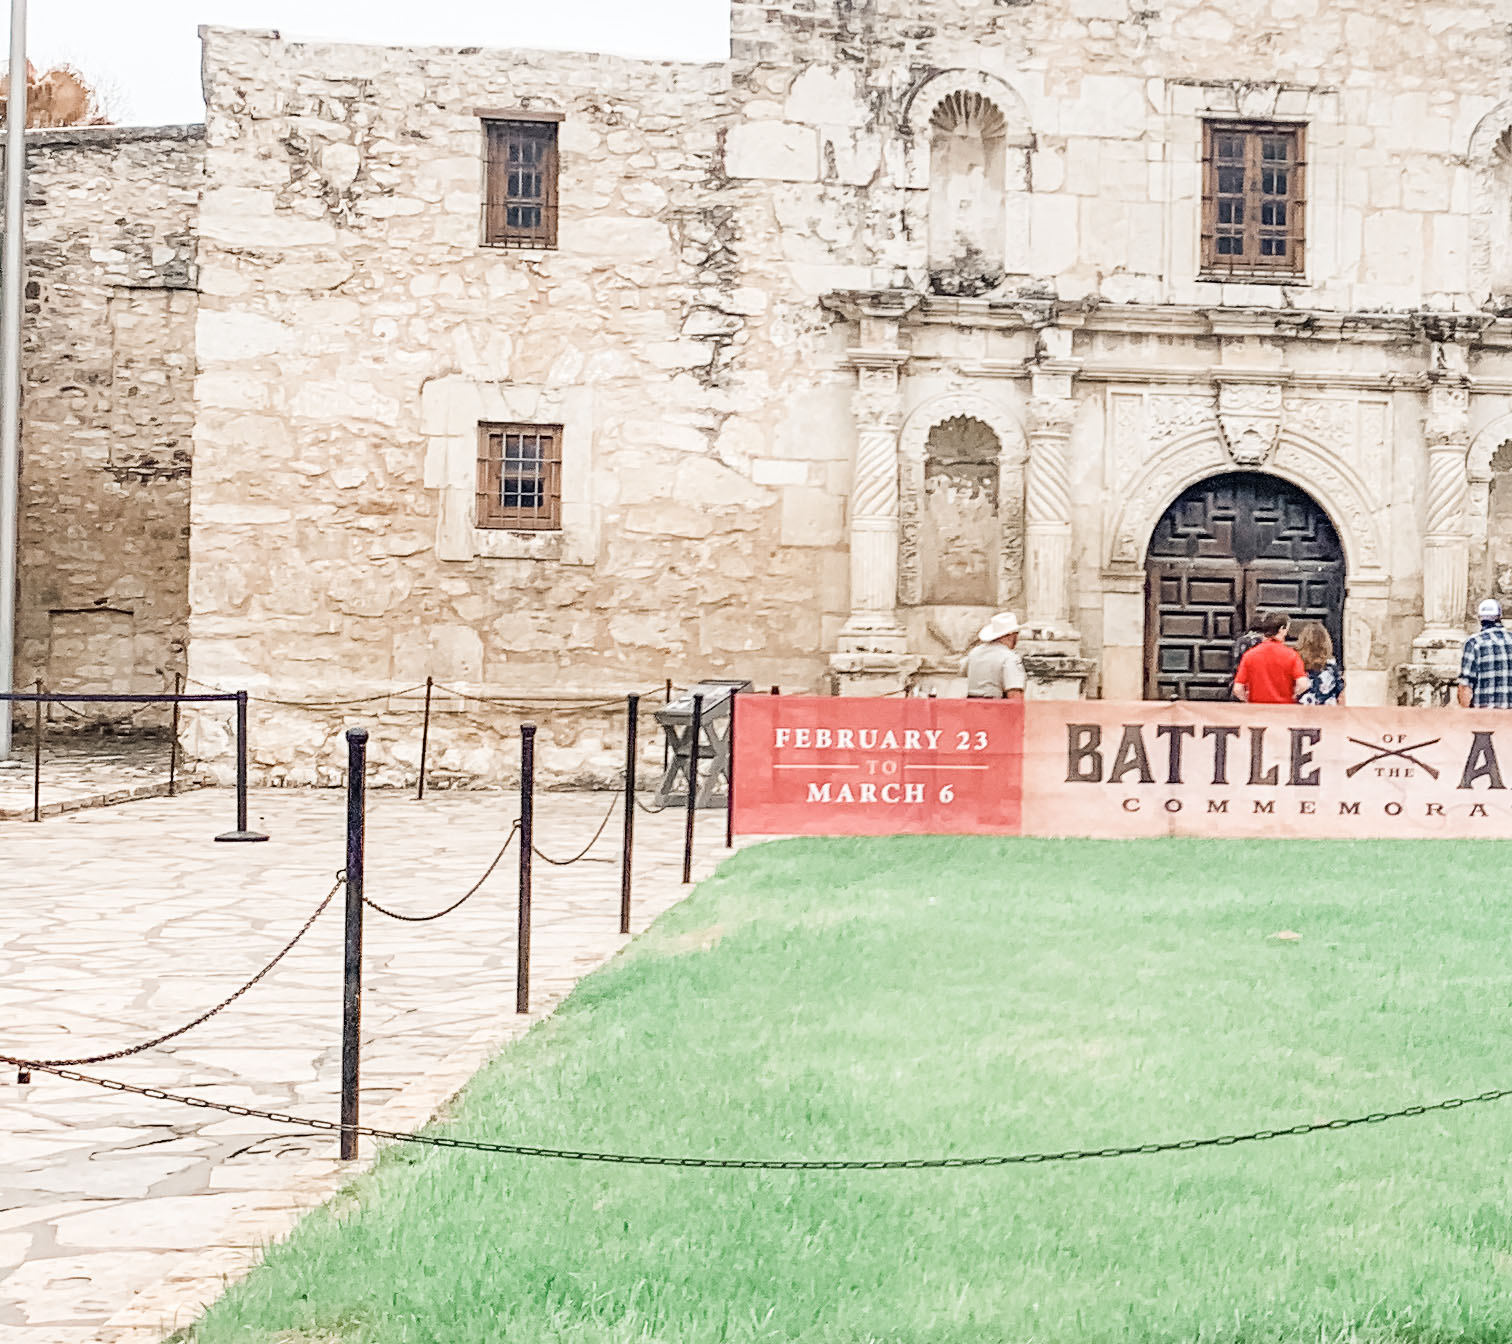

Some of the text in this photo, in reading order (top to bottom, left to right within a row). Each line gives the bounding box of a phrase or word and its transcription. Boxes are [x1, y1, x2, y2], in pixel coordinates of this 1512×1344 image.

[774, 728, 989, 750] FEBRUARY 23
[1382, 734, 1408, 744] OF
[1064, 723, 1322, 786] BATTLE
[865, 760, 897, 775] TO
[1375, 767, 1414, 778] THE
[806, 783, 955, 804] MARCH 6
